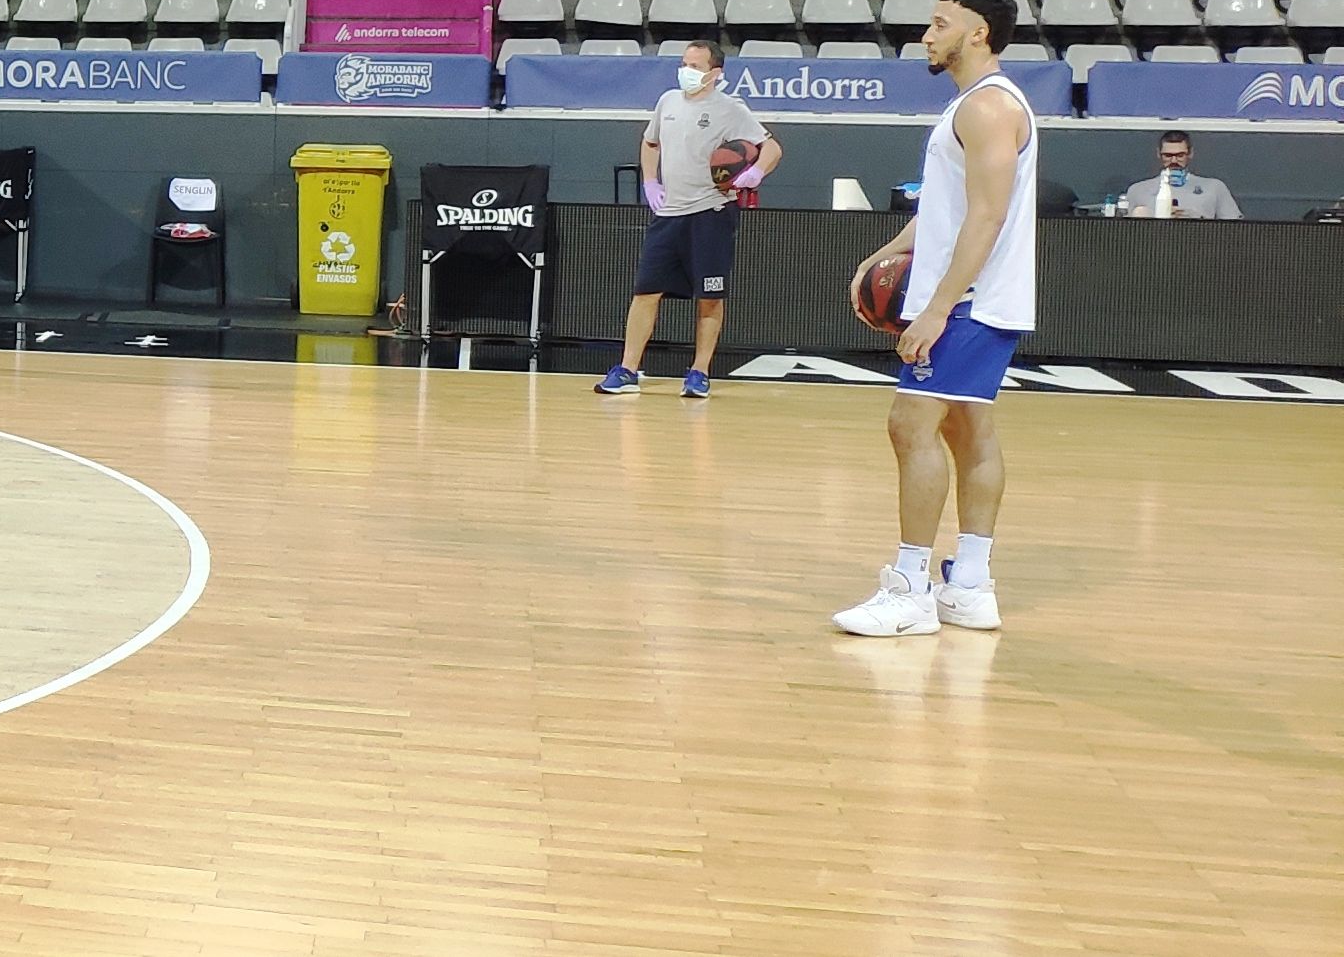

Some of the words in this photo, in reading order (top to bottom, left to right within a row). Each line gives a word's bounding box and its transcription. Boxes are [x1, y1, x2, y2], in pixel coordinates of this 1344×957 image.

[354, 26, 399, 39] andorra
[401, 25, 449, 38] telecom
[367, 65, 429, 74] MORABANC
[366, 73, 429, 89] ANDORRA
[731, 65, 886, 102] Andorra
[436, 204, 535, 227] SPALDING
[318, 264, 357, 273] PLASTIC
[316, 274, 358, 284] ENVASOS
